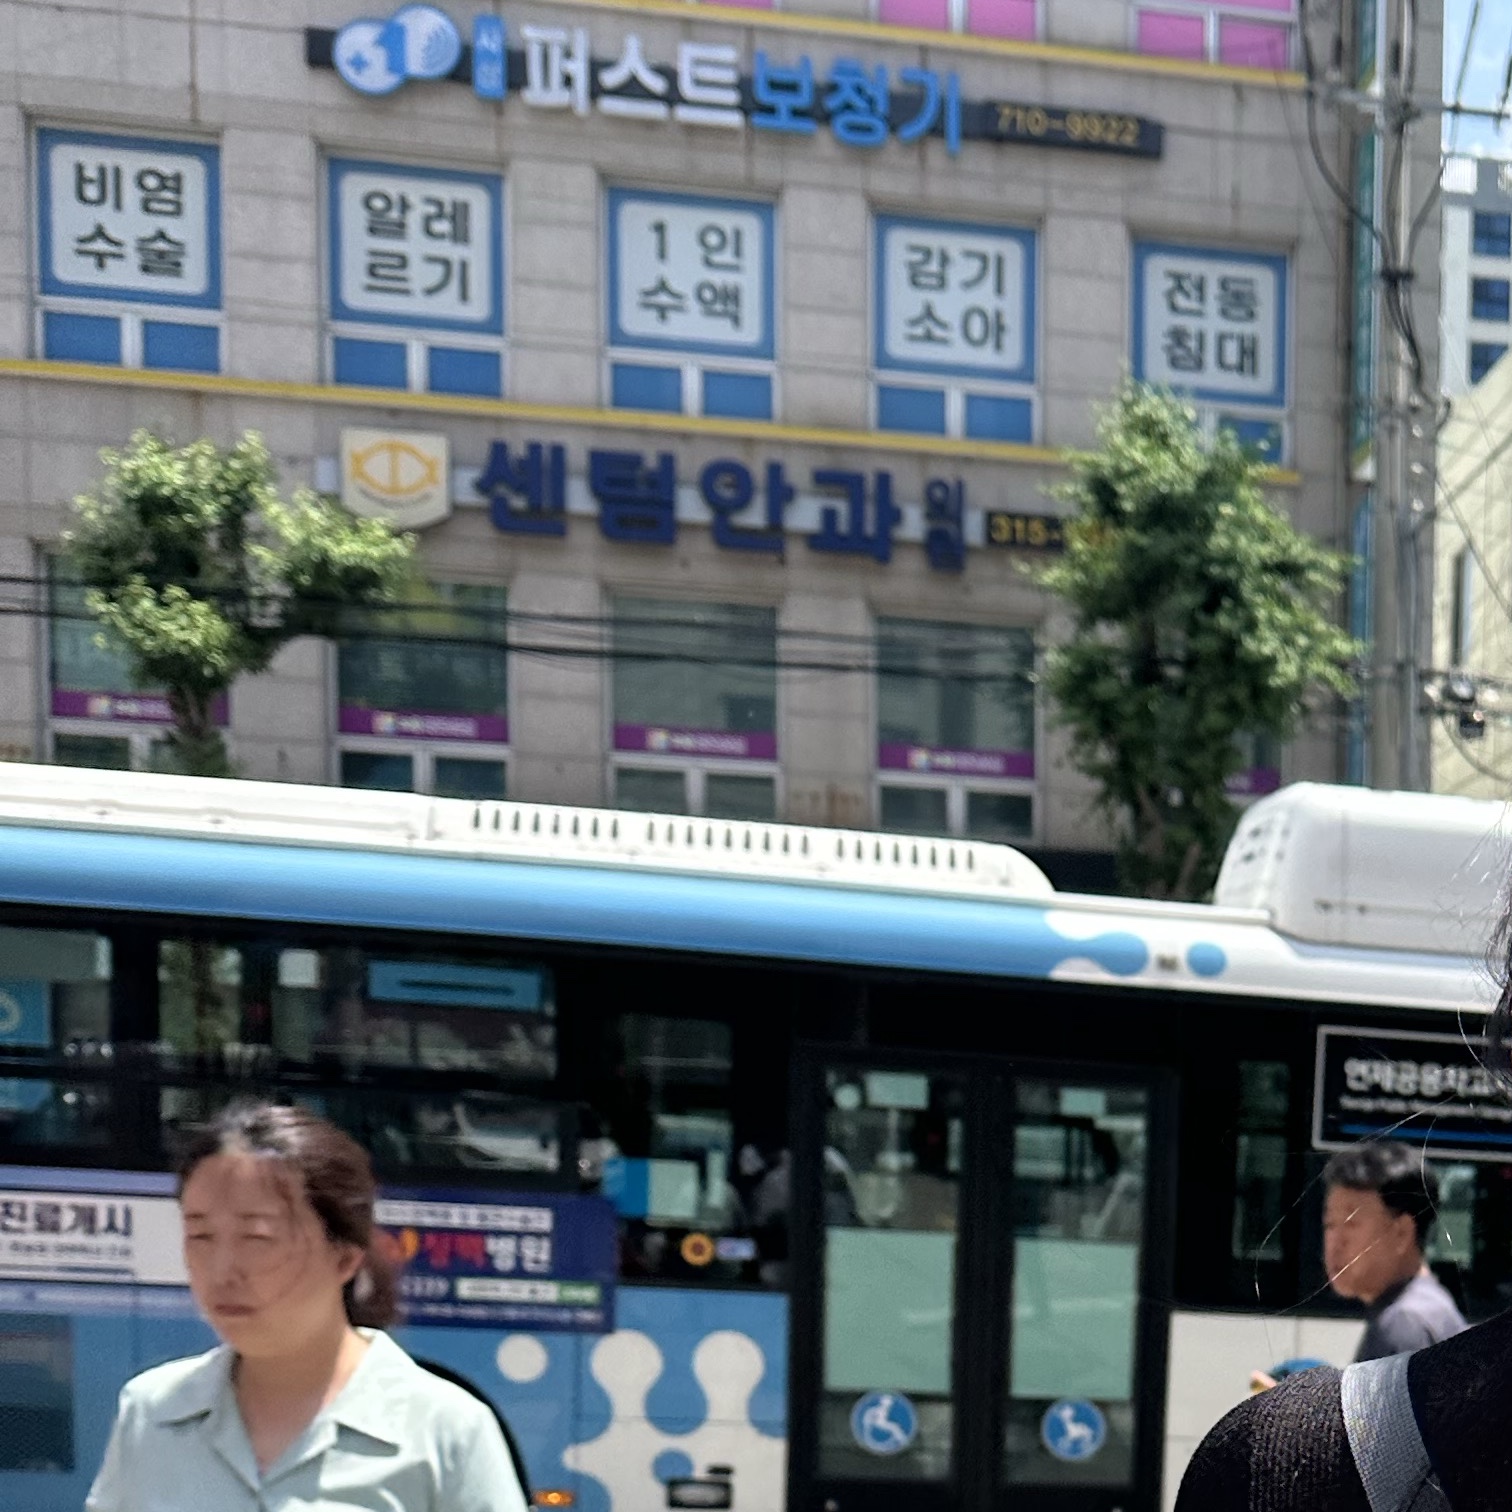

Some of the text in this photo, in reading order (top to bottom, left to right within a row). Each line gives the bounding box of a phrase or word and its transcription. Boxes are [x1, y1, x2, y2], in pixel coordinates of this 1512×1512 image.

[73, 160, 185, 218] 비염
[362, 187, 472, 246] 알레
[73, 221, 187, 279] 수술
[362, 248, 472, 303] 르기
[904, 243, 1006, 297] 감기
[638, 274, 744, 330] 수액
[1162, 267, 1261, 319] 전동
[904, 304, 1008, 354] 소아
[1162, 326, 1261, 378] 침대
